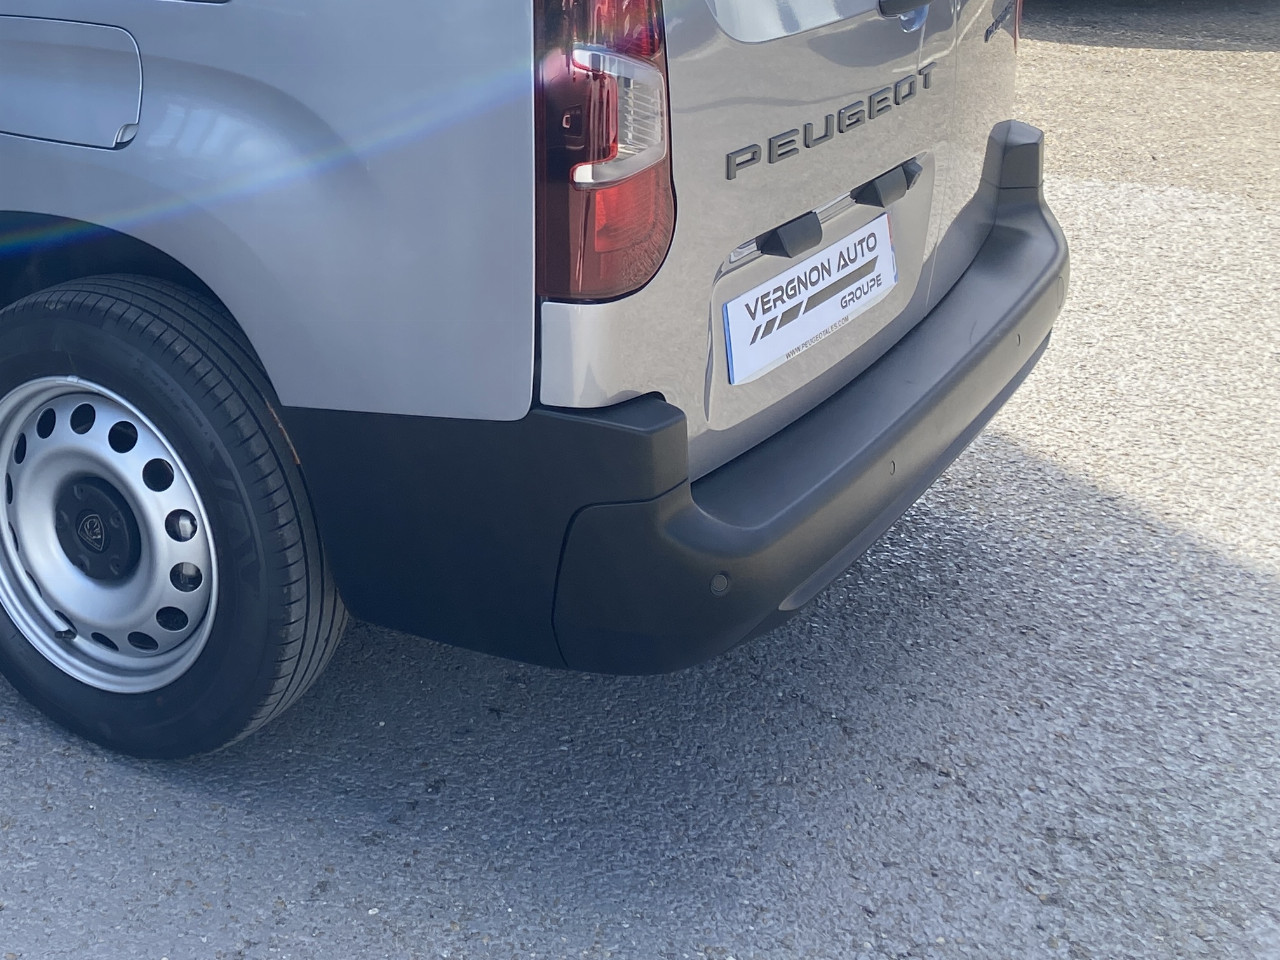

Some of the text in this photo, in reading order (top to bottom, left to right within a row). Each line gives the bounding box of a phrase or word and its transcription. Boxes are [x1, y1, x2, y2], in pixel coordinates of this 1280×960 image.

[726, 61, 937, 181] PEUGEOT
[744, 232, 878, 321] VERGNON AUTO
[840, 273, 883, 310] GROUPE
